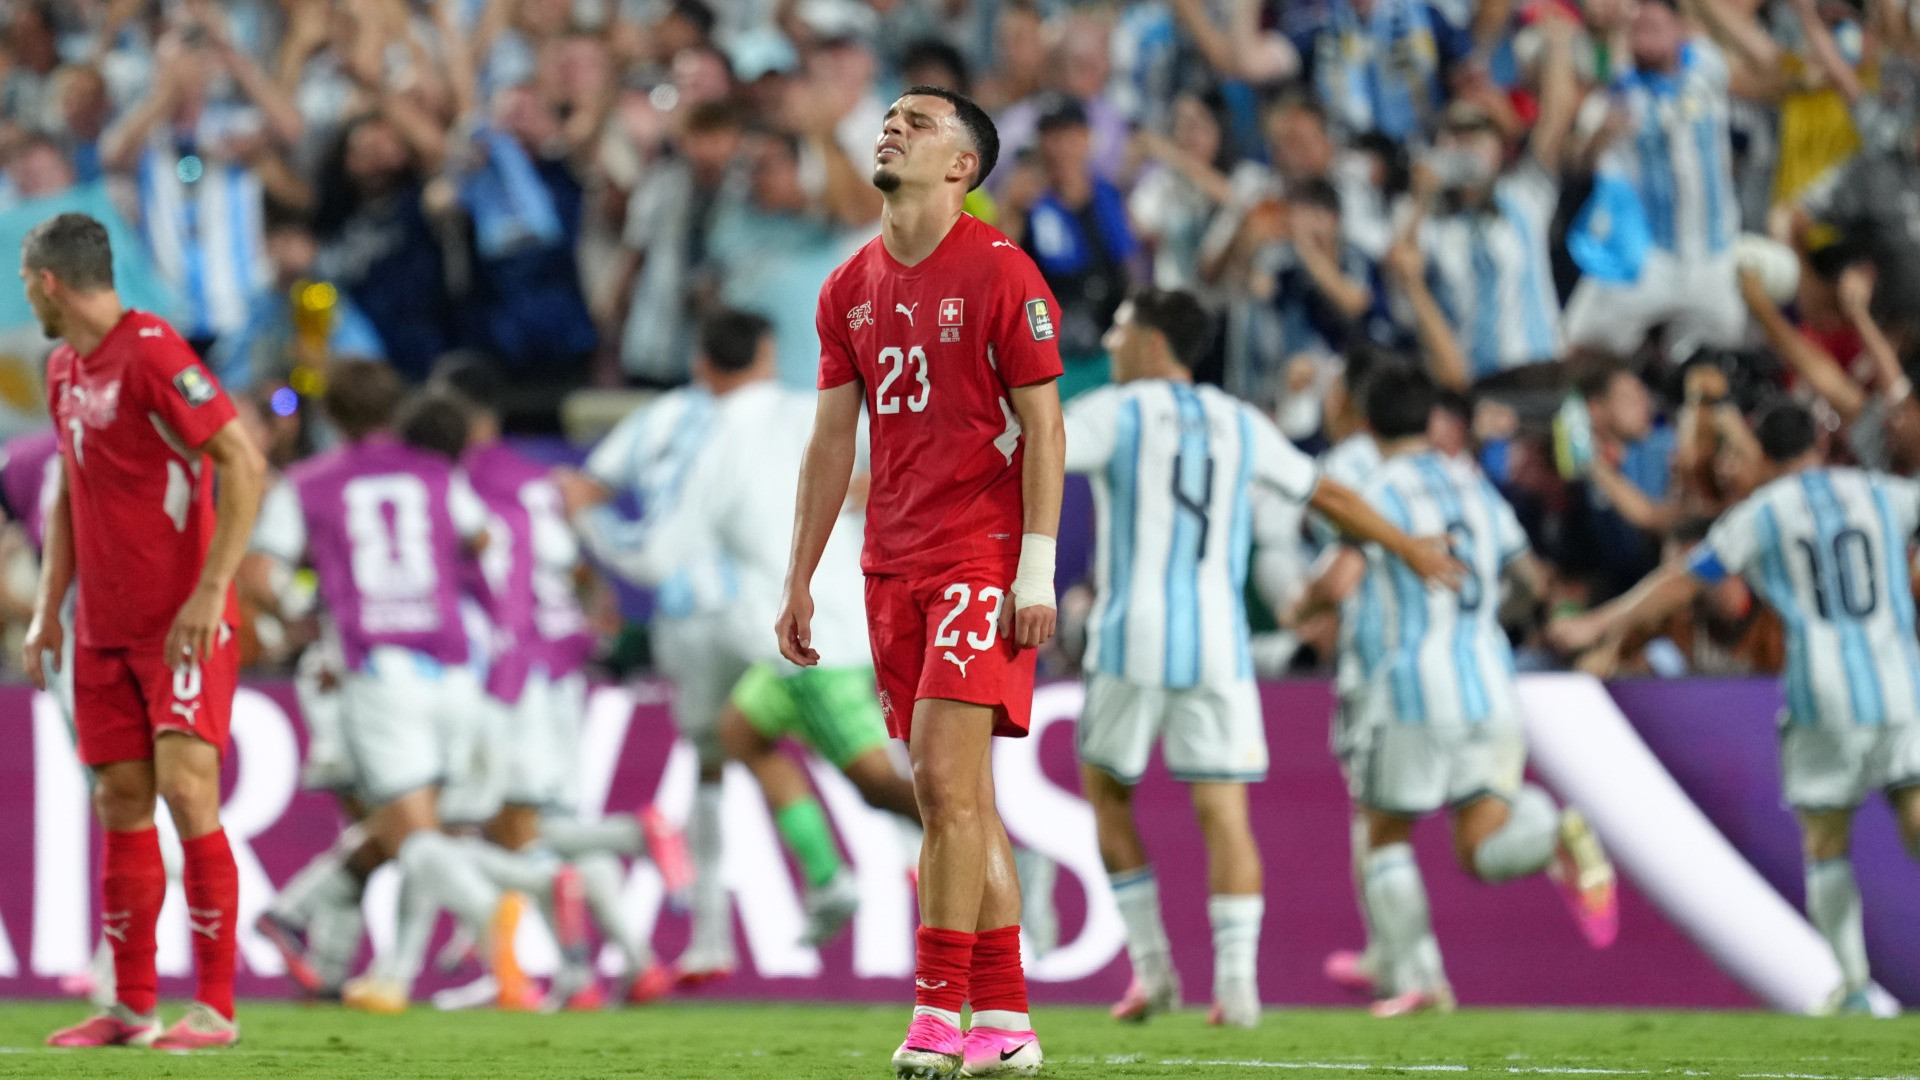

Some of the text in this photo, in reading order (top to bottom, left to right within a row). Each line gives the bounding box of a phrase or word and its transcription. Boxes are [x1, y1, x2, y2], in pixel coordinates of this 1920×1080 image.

[876, 346, 931, 414] 23
[1172, 454, 1214, 562] 4
[934, 583, 1005, 651] 23
[1797, 529, 1876, 619] 10
[0, 680, 1130, 982] IRAYS
